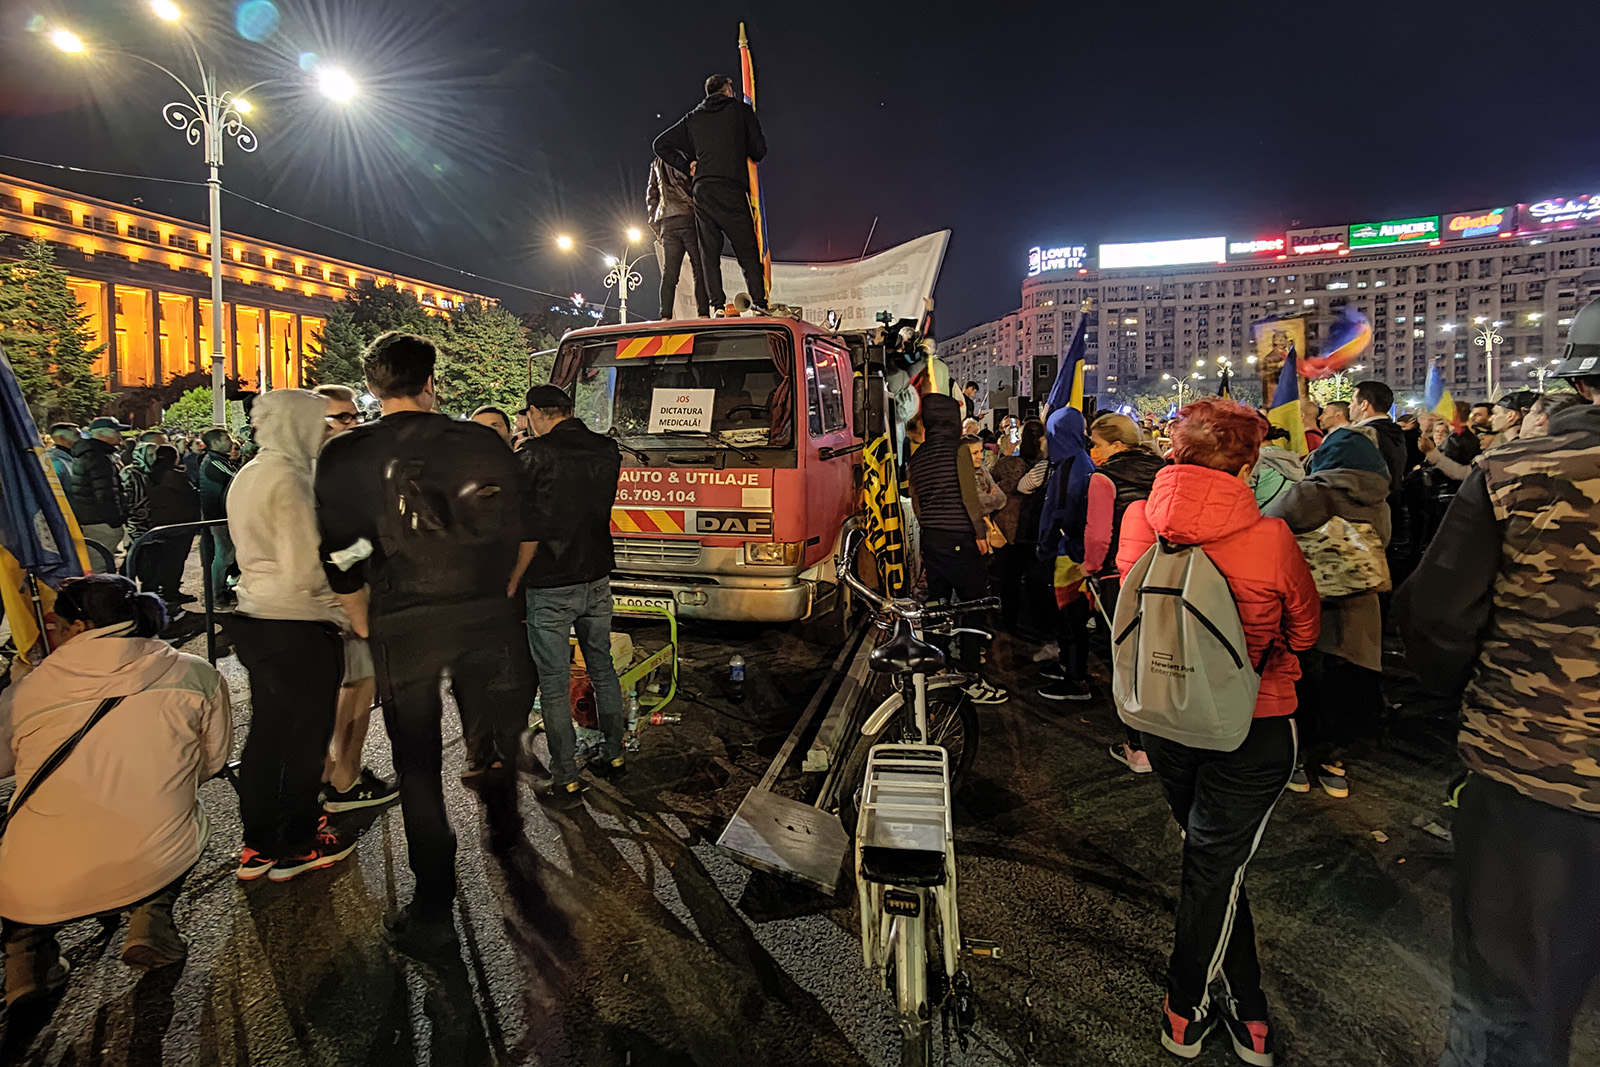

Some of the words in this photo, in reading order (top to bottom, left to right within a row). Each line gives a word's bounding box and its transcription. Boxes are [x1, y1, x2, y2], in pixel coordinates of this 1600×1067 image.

[1290, 233, 1343, 247] BORSEC
[1041, 247, 1071, 260] LOVE
[1041, 257, 1067, 271] LIVE
[676, 395, 690, 403] JOS
[660, 407, 703, 415] DICTATURA
[658, 418, 701, 427] MEDICALĂ!
[619, 471, 662, 483] AUTO
[667, 472, 680, 483] &
[686, 472, 759, 486] UTILAJE
[697, 517, 770, 532] DAF
[1151, 660, 1179, 671] Hewlett
